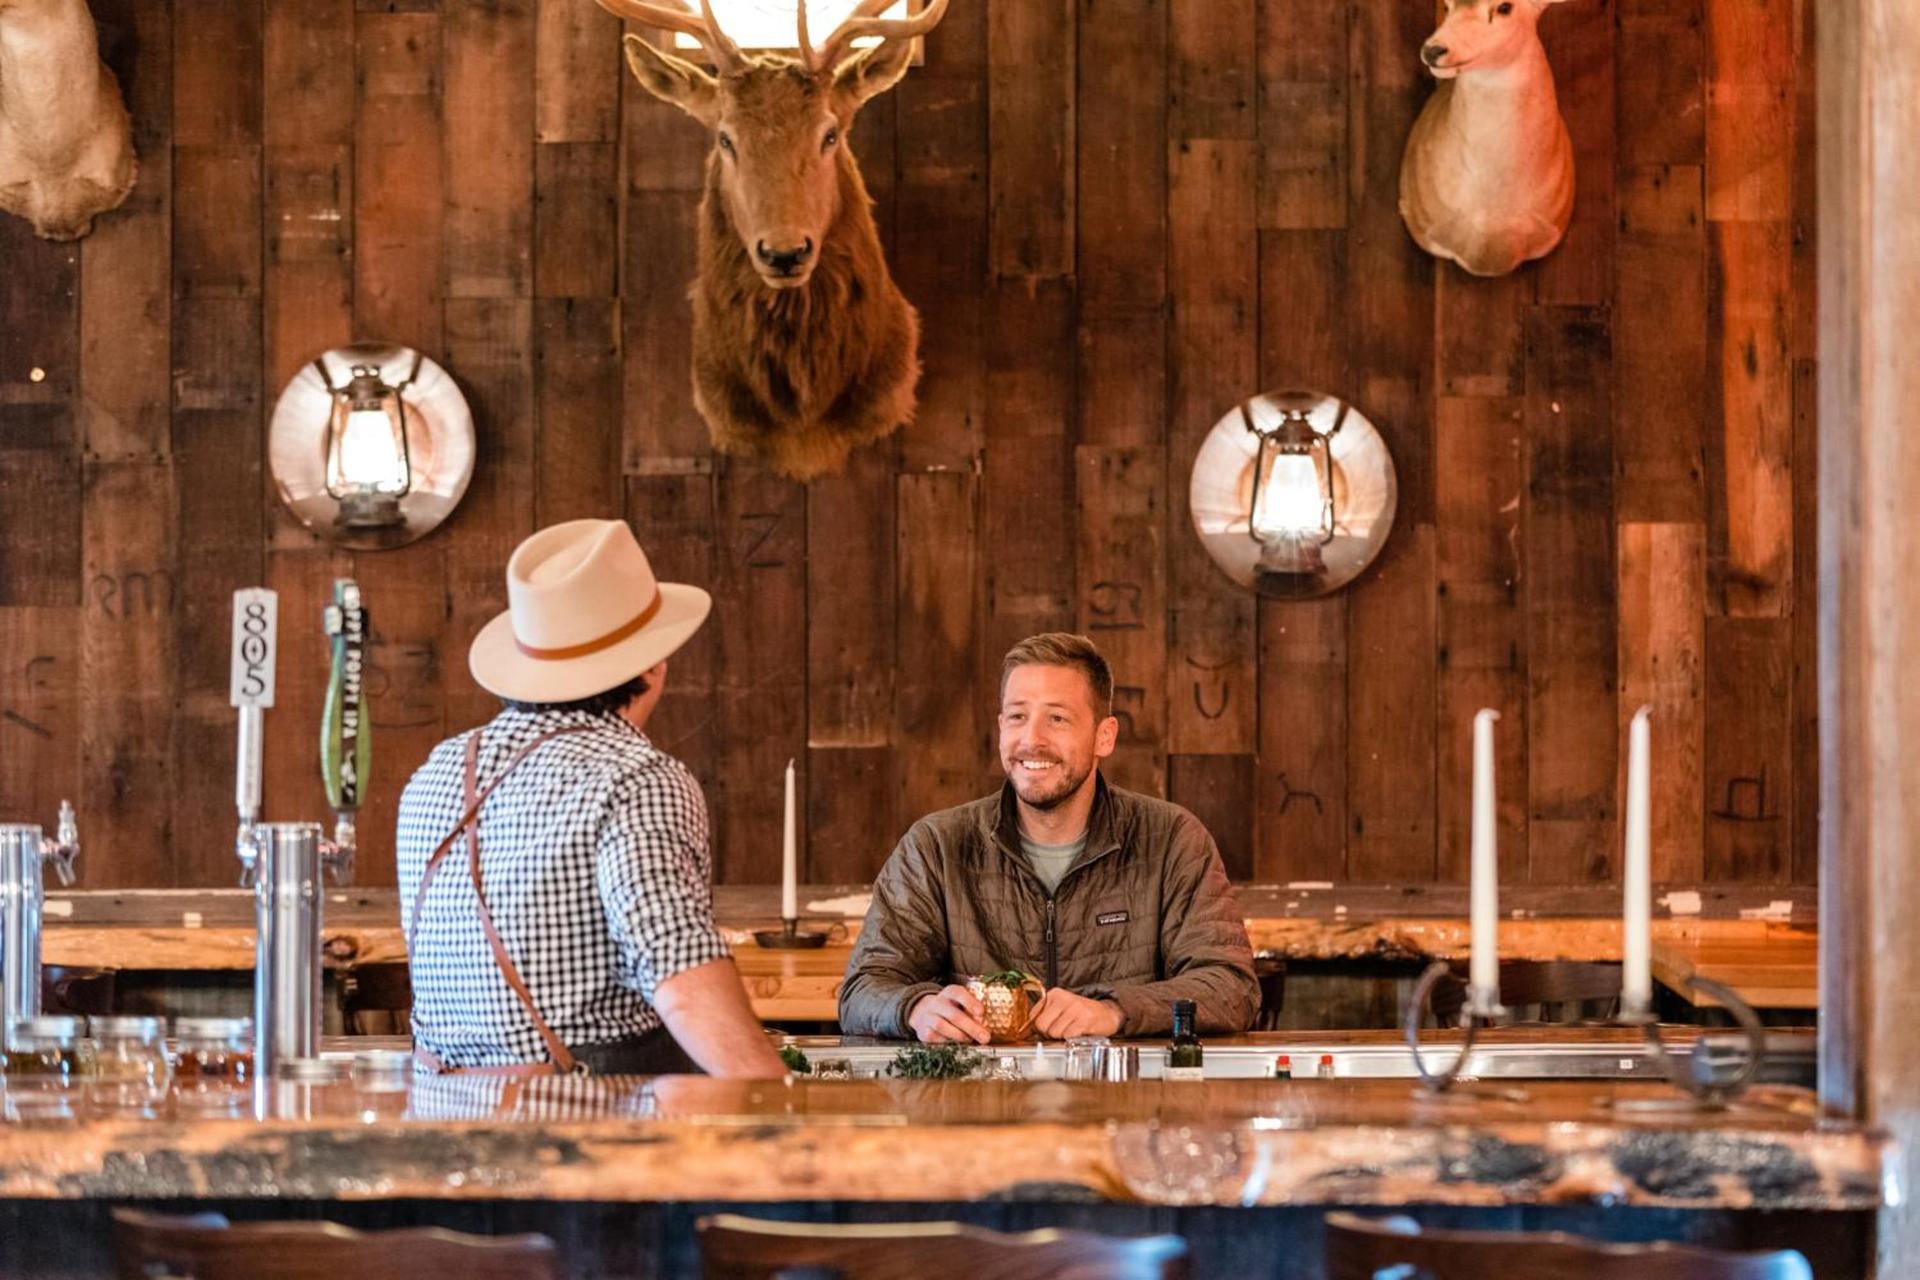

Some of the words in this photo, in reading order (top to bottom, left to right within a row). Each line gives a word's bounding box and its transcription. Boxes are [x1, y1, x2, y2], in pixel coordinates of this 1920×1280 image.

[241, 603, 267, 697] 805
[344, 650, 361, 703] POPPY
[343, 710, 358, 739] IPA
